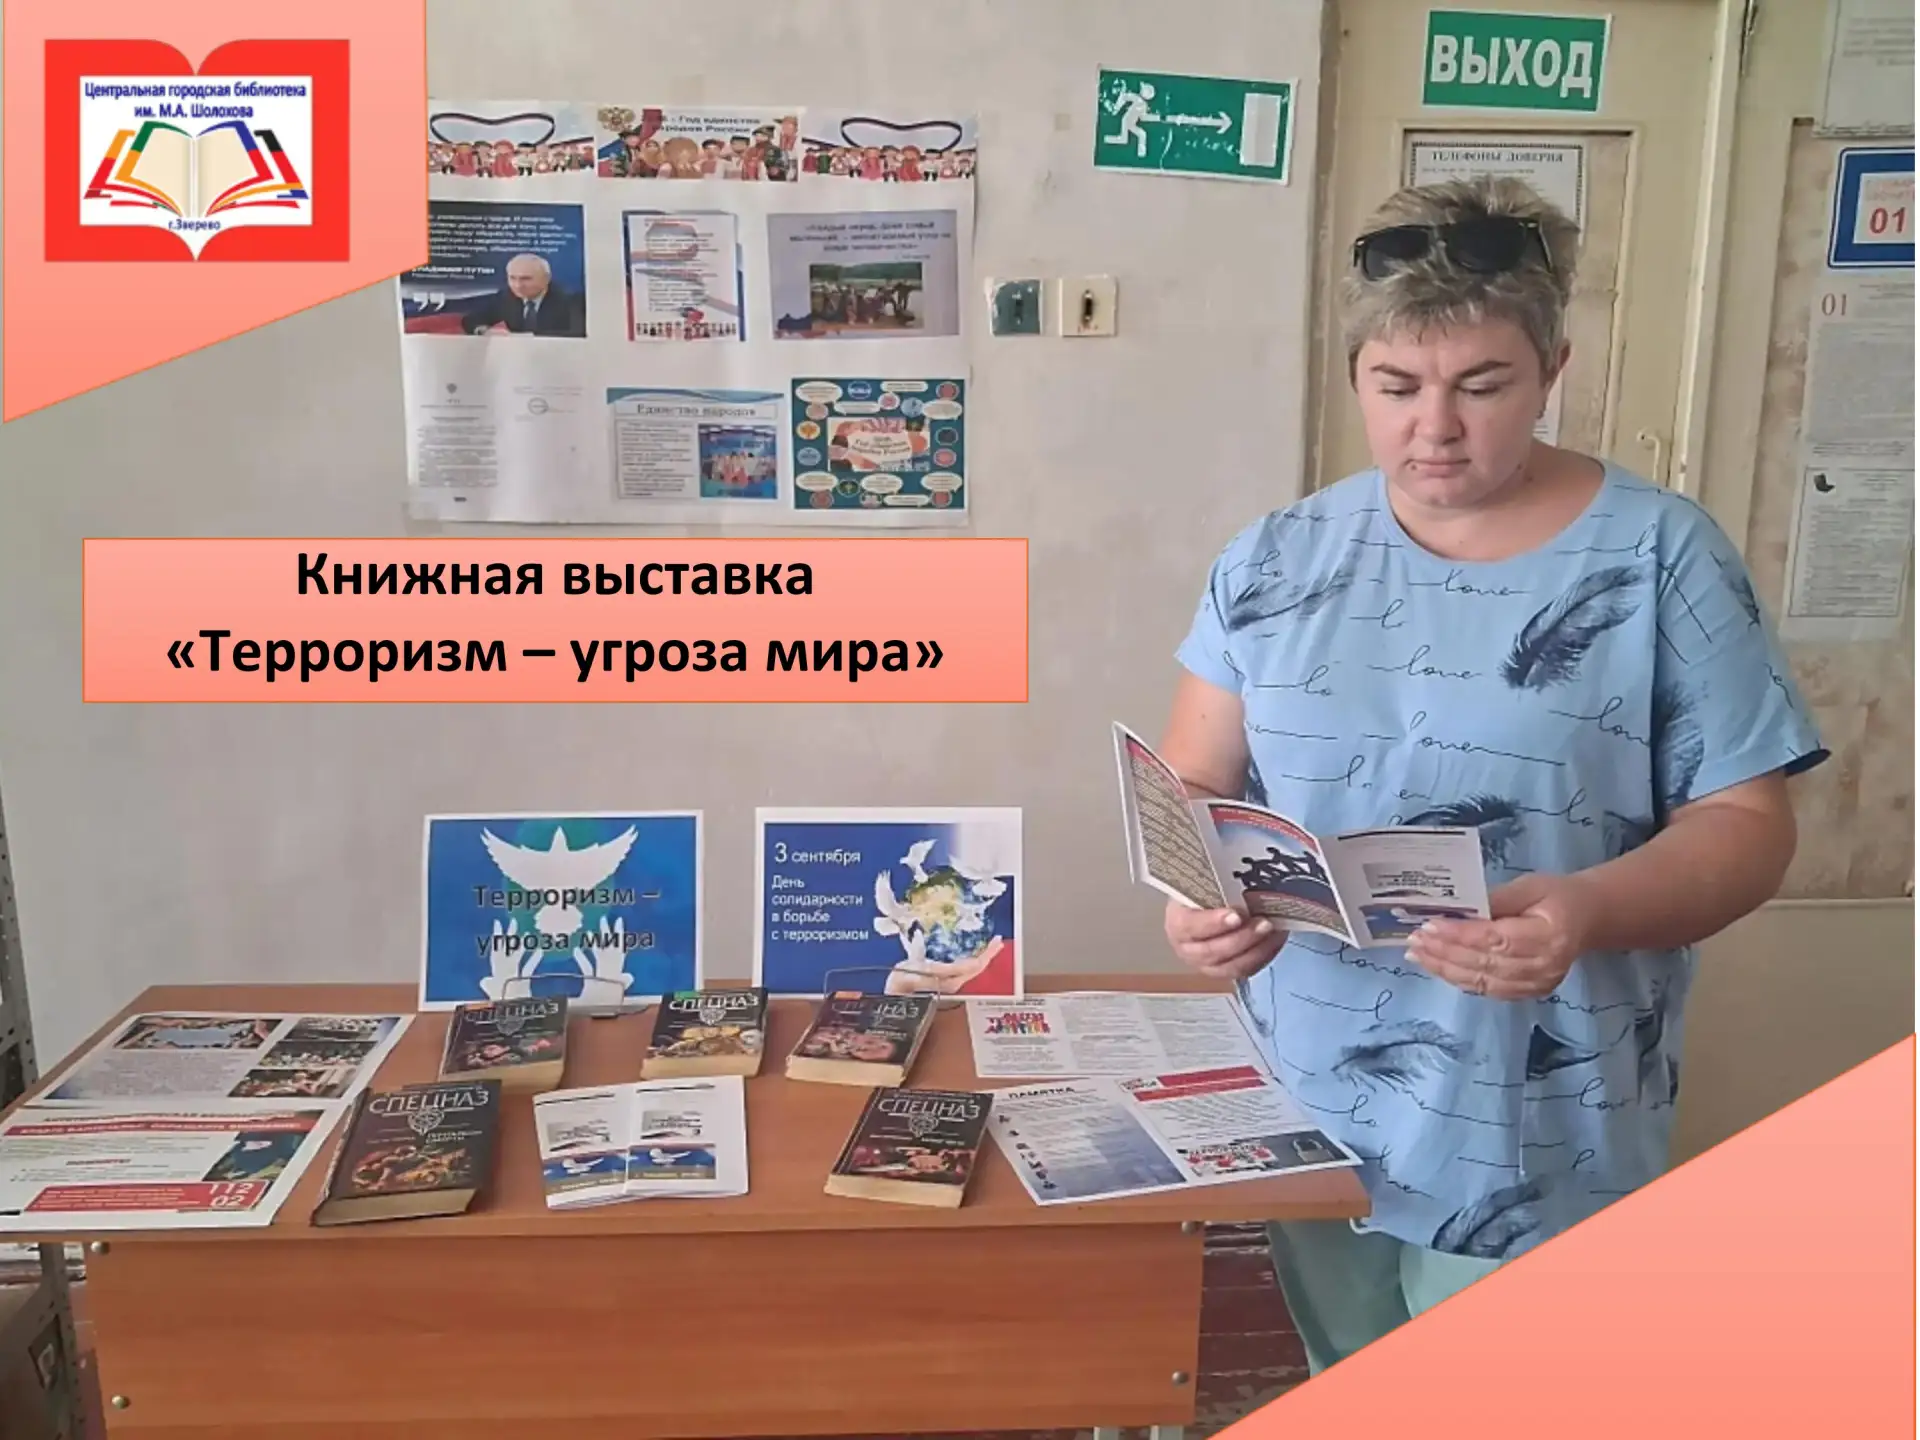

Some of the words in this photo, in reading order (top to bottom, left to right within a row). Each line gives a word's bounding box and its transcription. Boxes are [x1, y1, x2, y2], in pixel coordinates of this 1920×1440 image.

[1430, 34, 1593, 98] ВЫХОД
[1869, 206, 1906, 234] 01
[1821, 293, 1848, 316] 01
[774, 842, 788, 863] 3
[791, 849, 862, 866] сентября
[771, 875, 805, 890] День
[473, 885, 636, 912] Терроризм
[771, 894, 864, 909] солидарности
[771, 912, 780, 923] в
[784, 910, 831, 925] борьбе
[477, 931, 569, 956] угроза
[579, 931, 655, 955] мира
[771, 930, 778, 940] с
[783, 930, 869, 943] терроризмом
[369, 1090, 490, 1115] СПЕЦНАЗ
[877, 1098, 981, 1120] СПЕЦНАЗ
[208, 1182, 255, 1195] 112
[210, 1195, 245, 1208] 02
